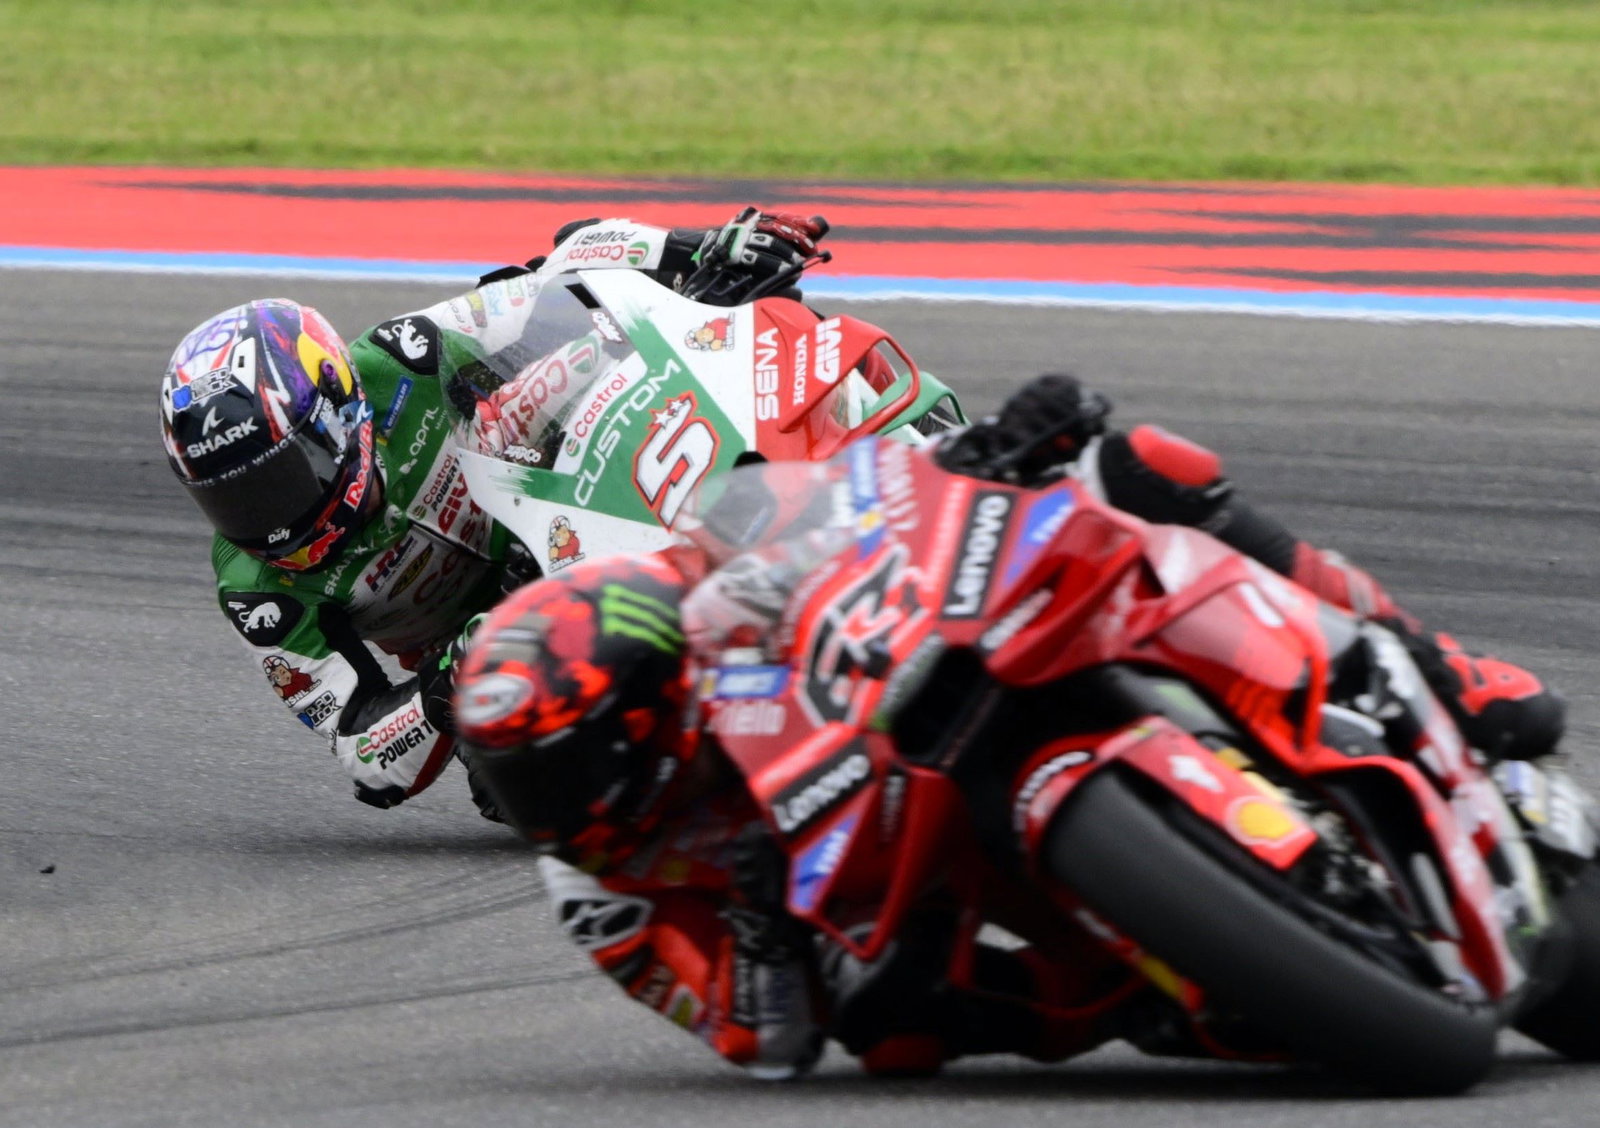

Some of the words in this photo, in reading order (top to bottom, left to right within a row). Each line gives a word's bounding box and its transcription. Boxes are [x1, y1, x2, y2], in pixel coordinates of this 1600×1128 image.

[756, 327, 780, 421] SENA
[792, 333, 808, 406] HONDA
[815, 316, 842, 385] GIVI
[186, 416, 259, 459] SHARK
[574, 372, 629, 439] Castrol
[574, 358, 682, 507] CUSTOM
[219, 465, 247, 482] YOU
[251, 432, 297, 467] WINGS
[423, 454, 454, 506] Castrol
[631, 390, 721, 534] 5
[267, 528, 291, 544] Dafy
[946, 496, 1010, 616] Lenovo
[369, 701, 420, 749] Castrol
